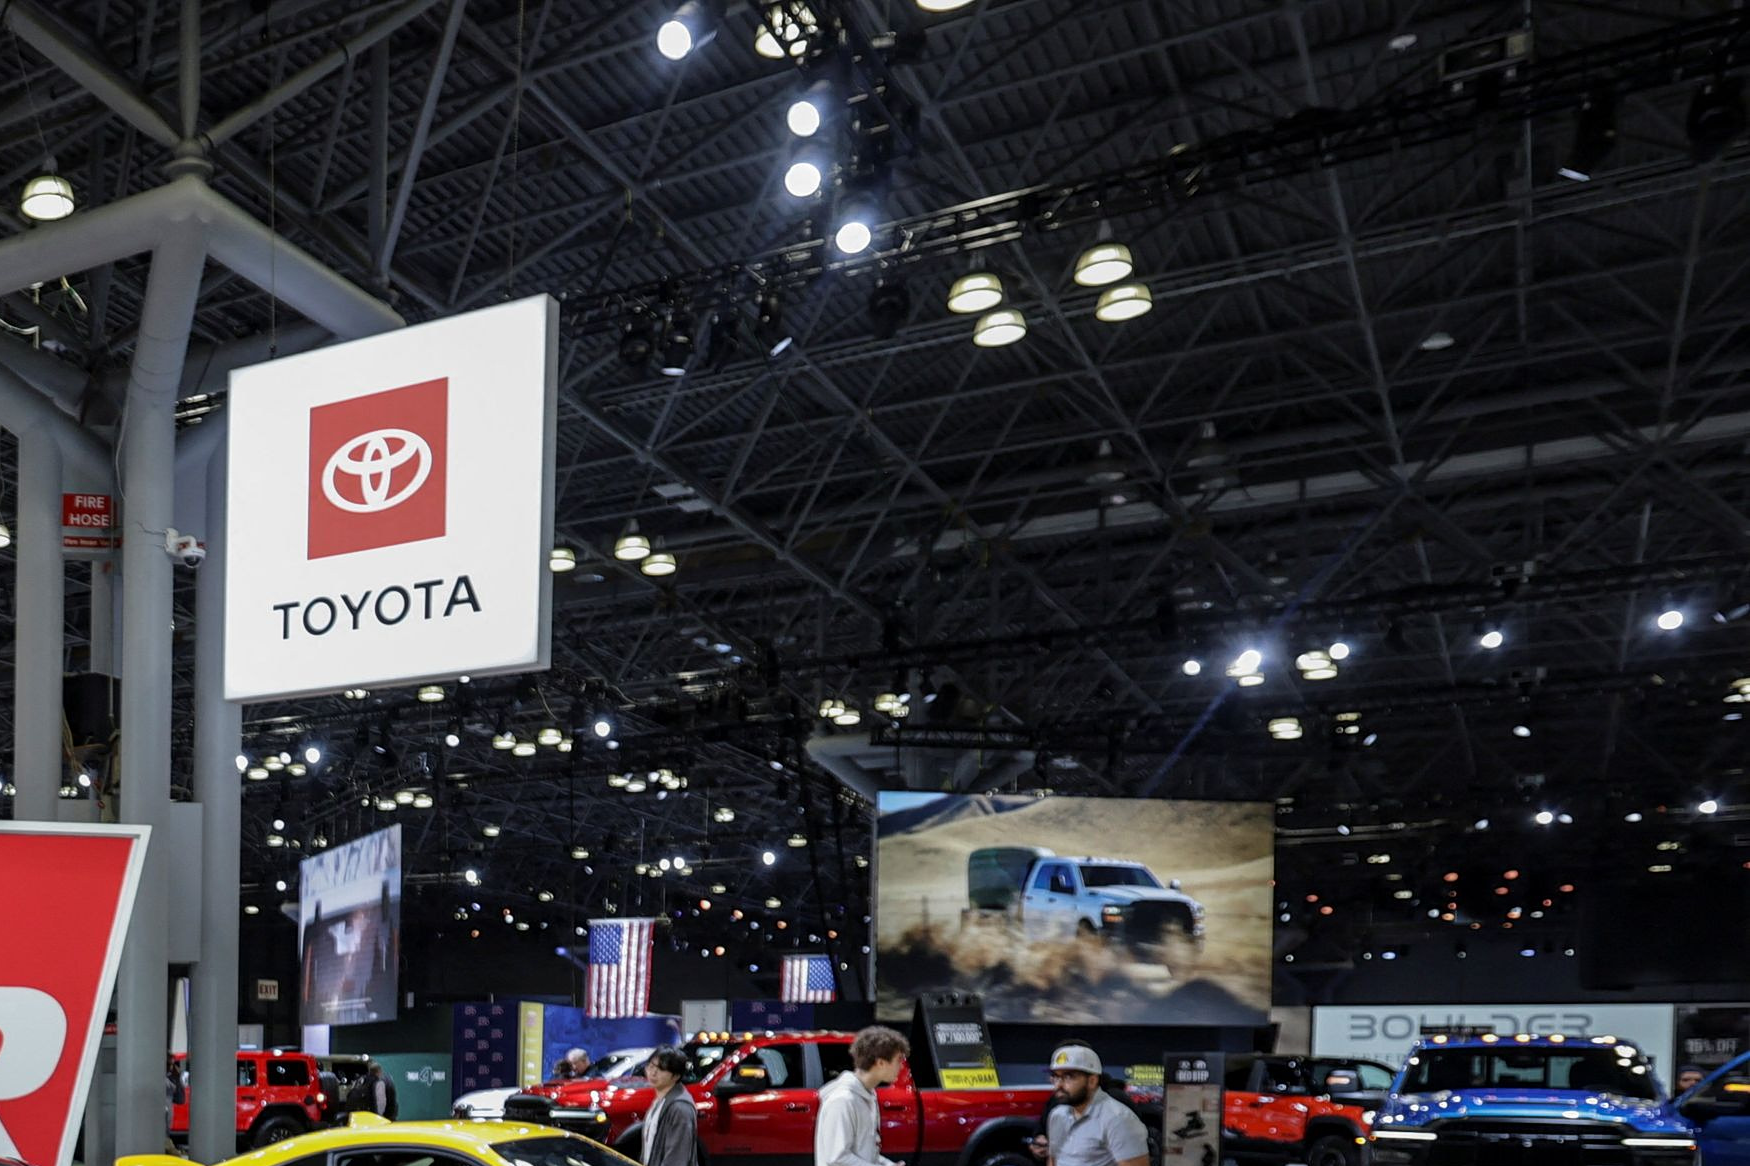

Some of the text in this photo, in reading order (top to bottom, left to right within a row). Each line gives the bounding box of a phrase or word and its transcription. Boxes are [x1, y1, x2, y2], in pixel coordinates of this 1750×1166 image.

[75, 495, 105, 509] FIRE
[69, 513, 110, 527] HOSE
[272, 574, 482, 640] TOYOTA
